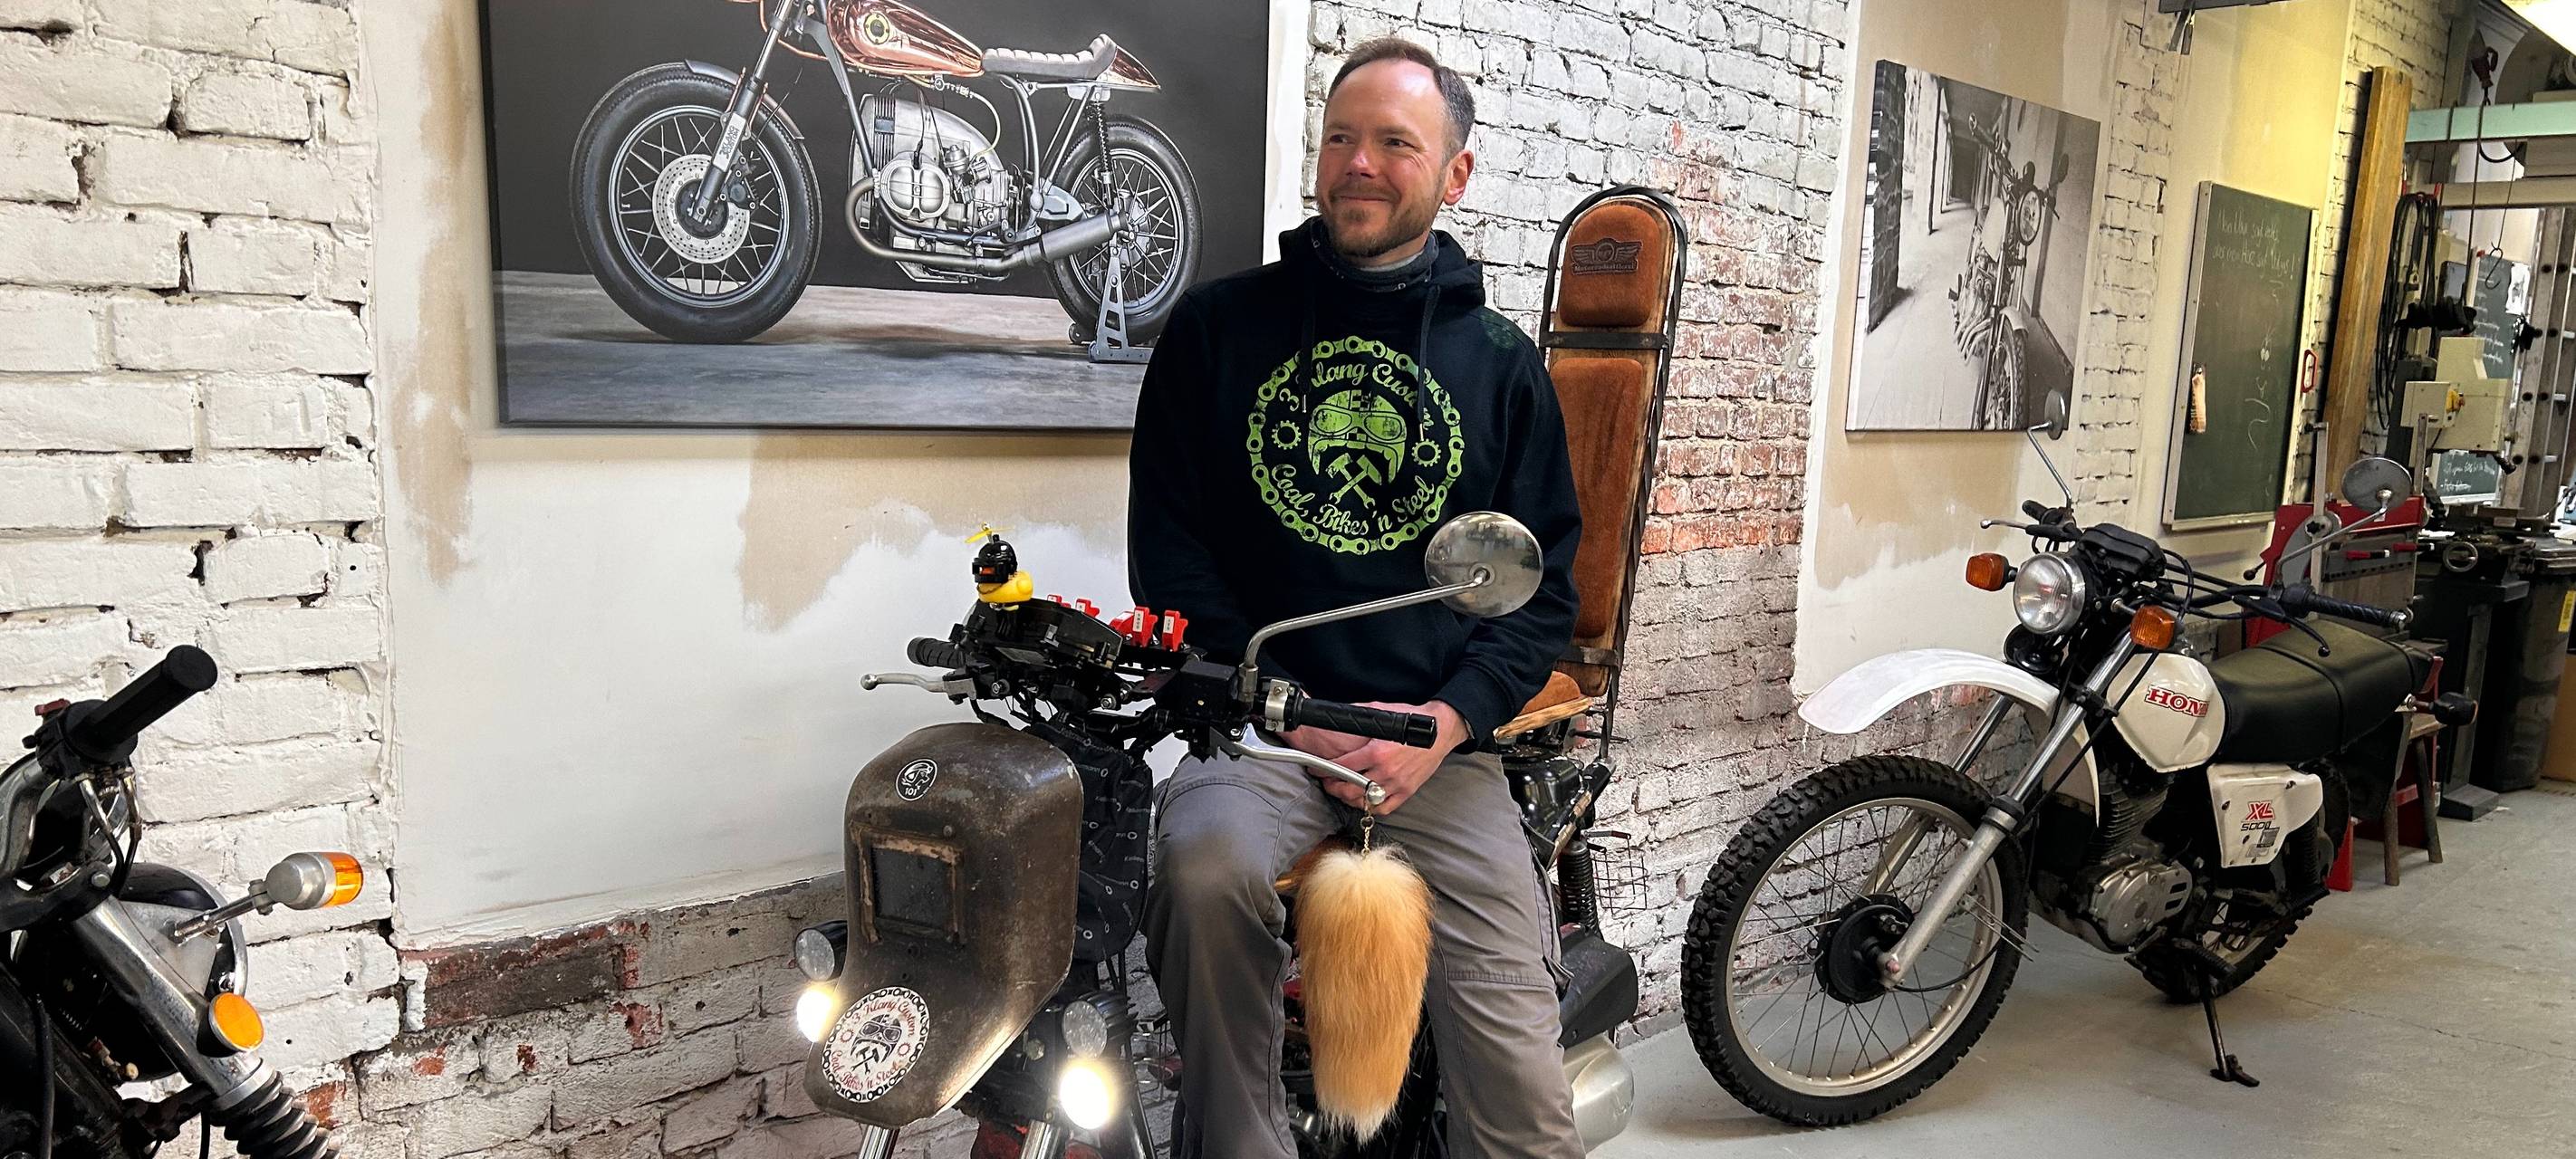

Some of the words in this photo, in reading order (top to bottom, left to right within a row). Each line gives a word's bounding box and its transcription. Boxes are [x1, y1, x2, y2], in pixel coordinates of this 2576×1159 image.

[1279, 388, 1300, 411] 3
[1295, 361, 1369, 388] lang
[1312, 503, 1369, 536] Bikes
[1391, 475, 1434, 522] Steel
[905, 787, 918, 796] 101
[2245, 800, 2275, 820] XL
[851, 1012, 861, 1024] 3
